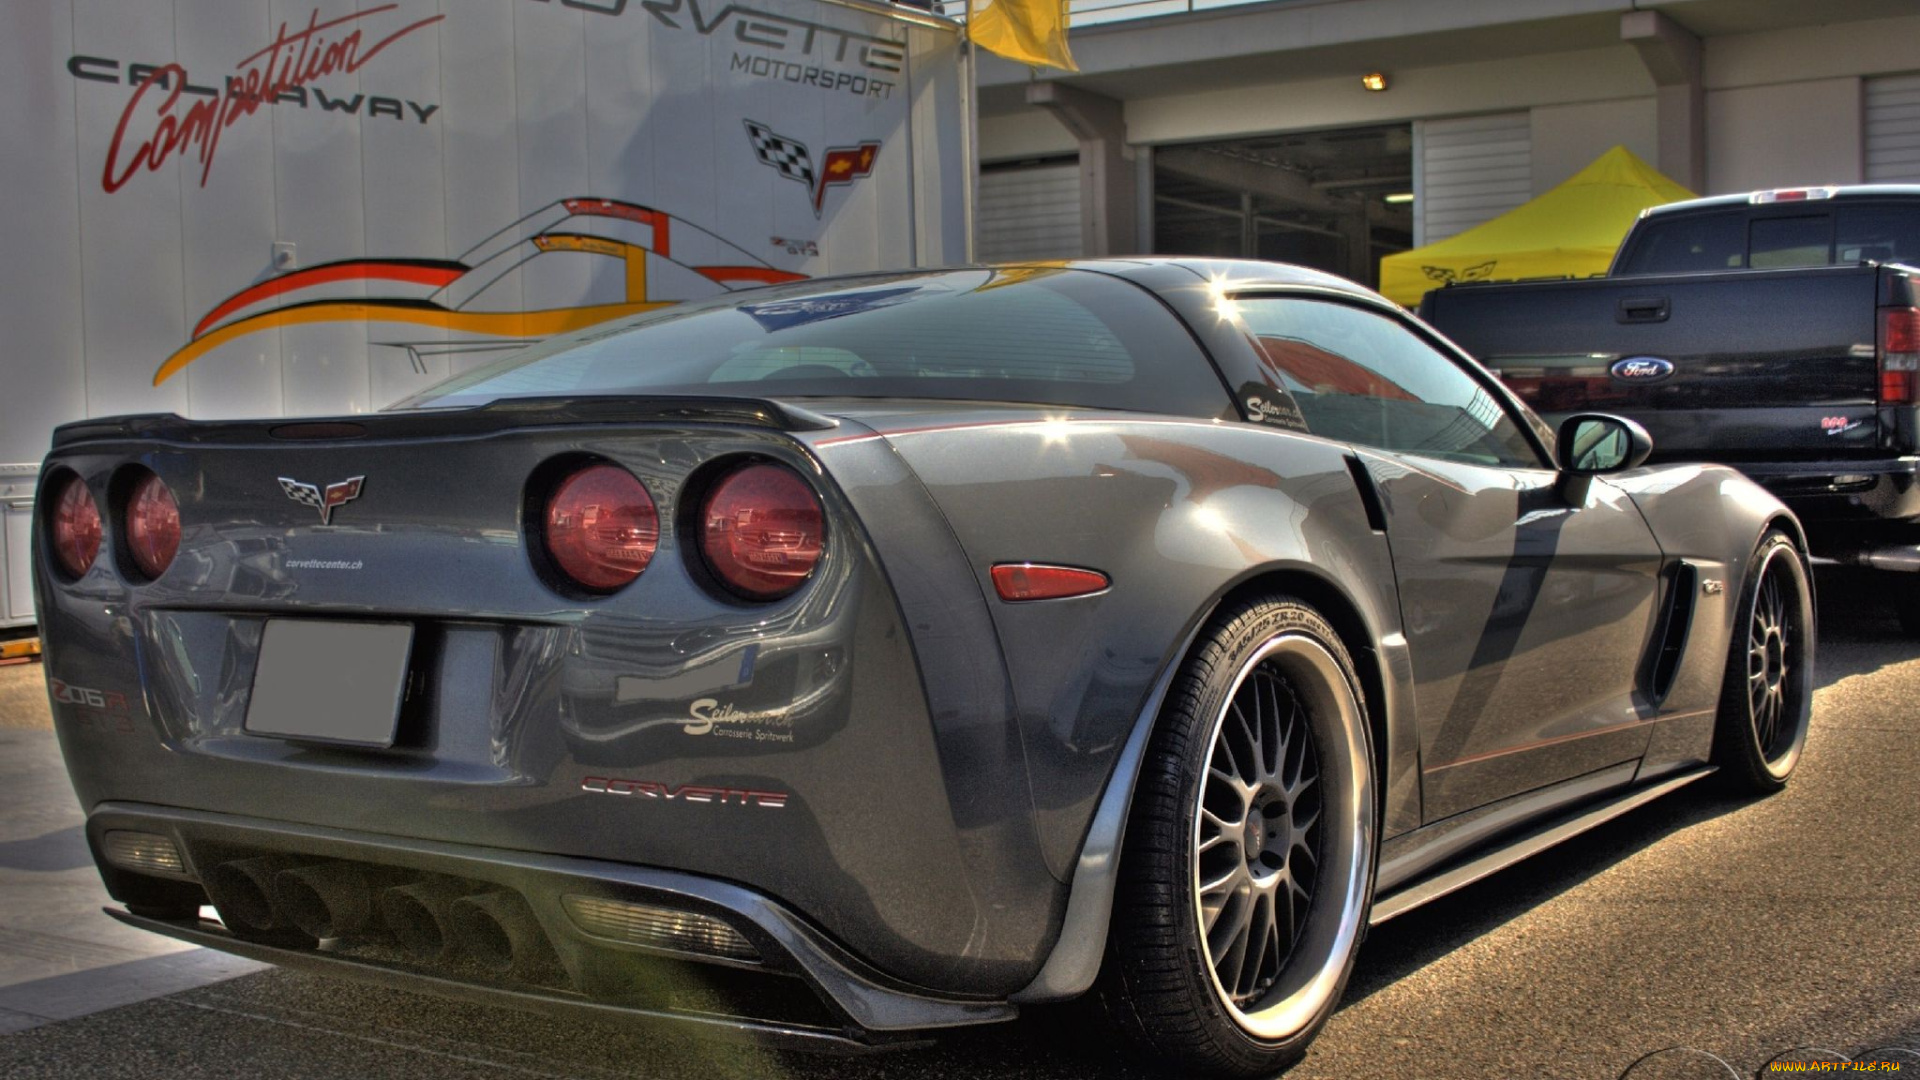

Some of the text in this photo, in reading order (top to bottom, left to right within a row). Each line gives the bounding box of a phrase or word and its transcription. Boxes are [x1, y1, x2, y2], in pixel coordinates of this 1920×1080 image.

[730, 52, 896, 99] MOTORSPORT
[103, 4, 446, 193] Competition
[1623, 361, 1658, 377] Ford
[581, 776, 788, 808] CORVETTE
